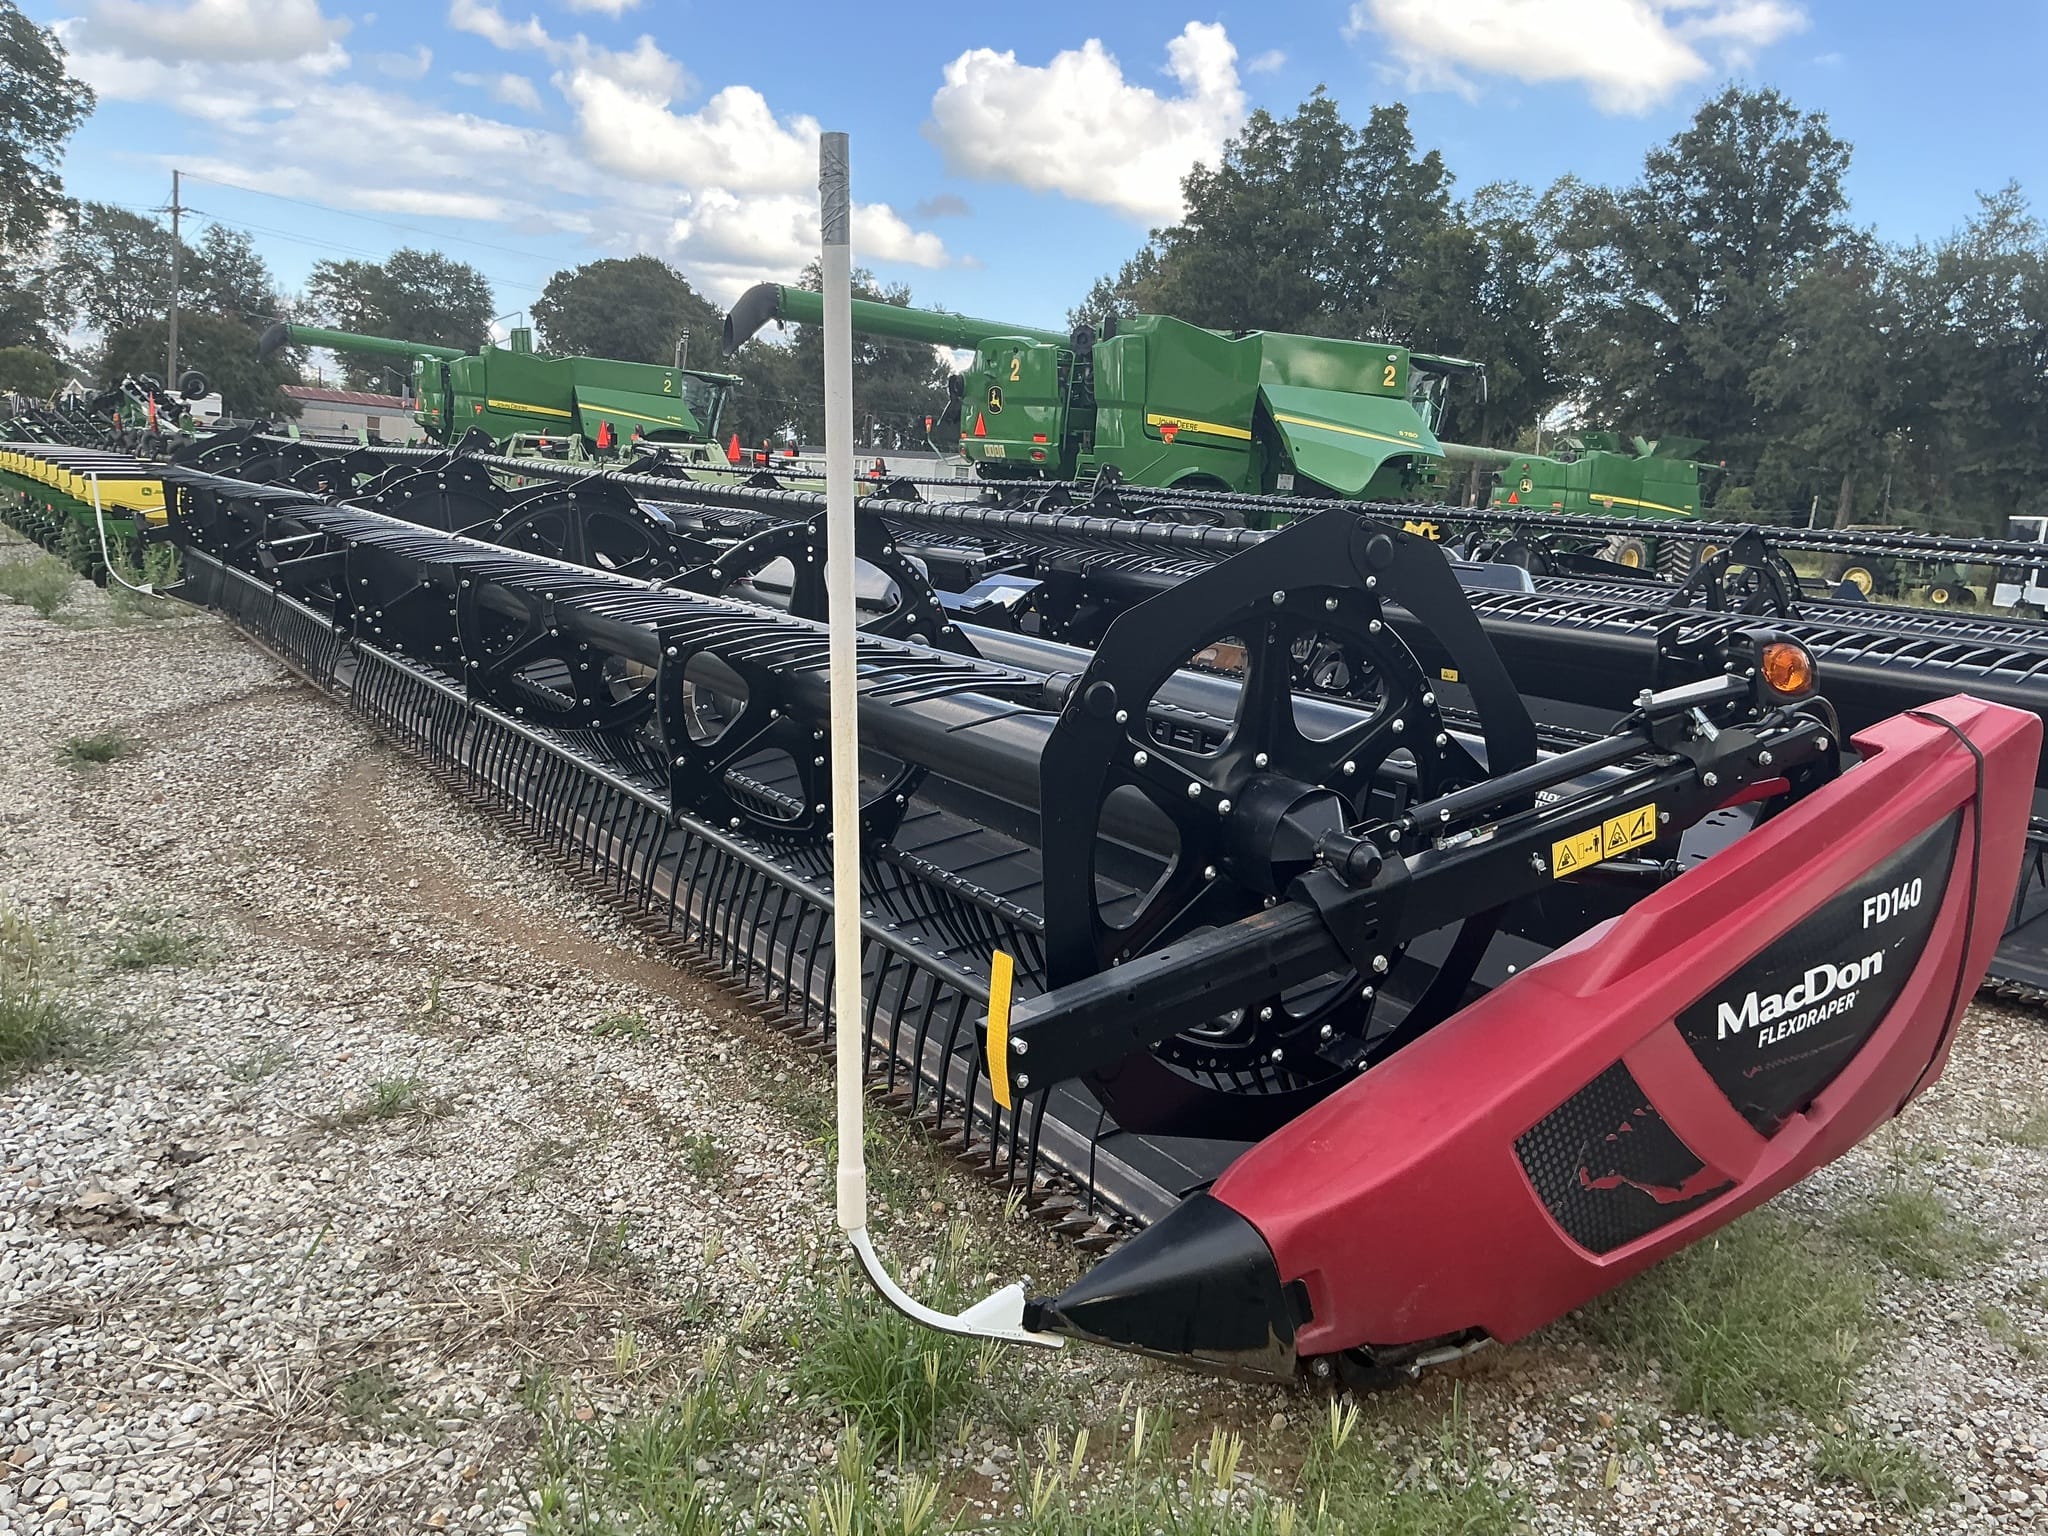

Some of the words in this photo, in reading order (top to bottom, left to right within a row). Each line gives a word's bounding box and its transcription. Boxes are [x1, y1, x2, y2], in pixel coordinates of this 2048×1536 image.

[1010, 358, 1020, 382] 2
[1383, 365, 1396, 387] 2
[664, 379, 672, 393] 2
[1178, 419, 1199, 431] DEERE
[1862, 877, 1923, 929] FD140
[1717, 950, 1884, 1040] MacDon
[1758, 991, 1859, 1049] FLEXDRAPER
